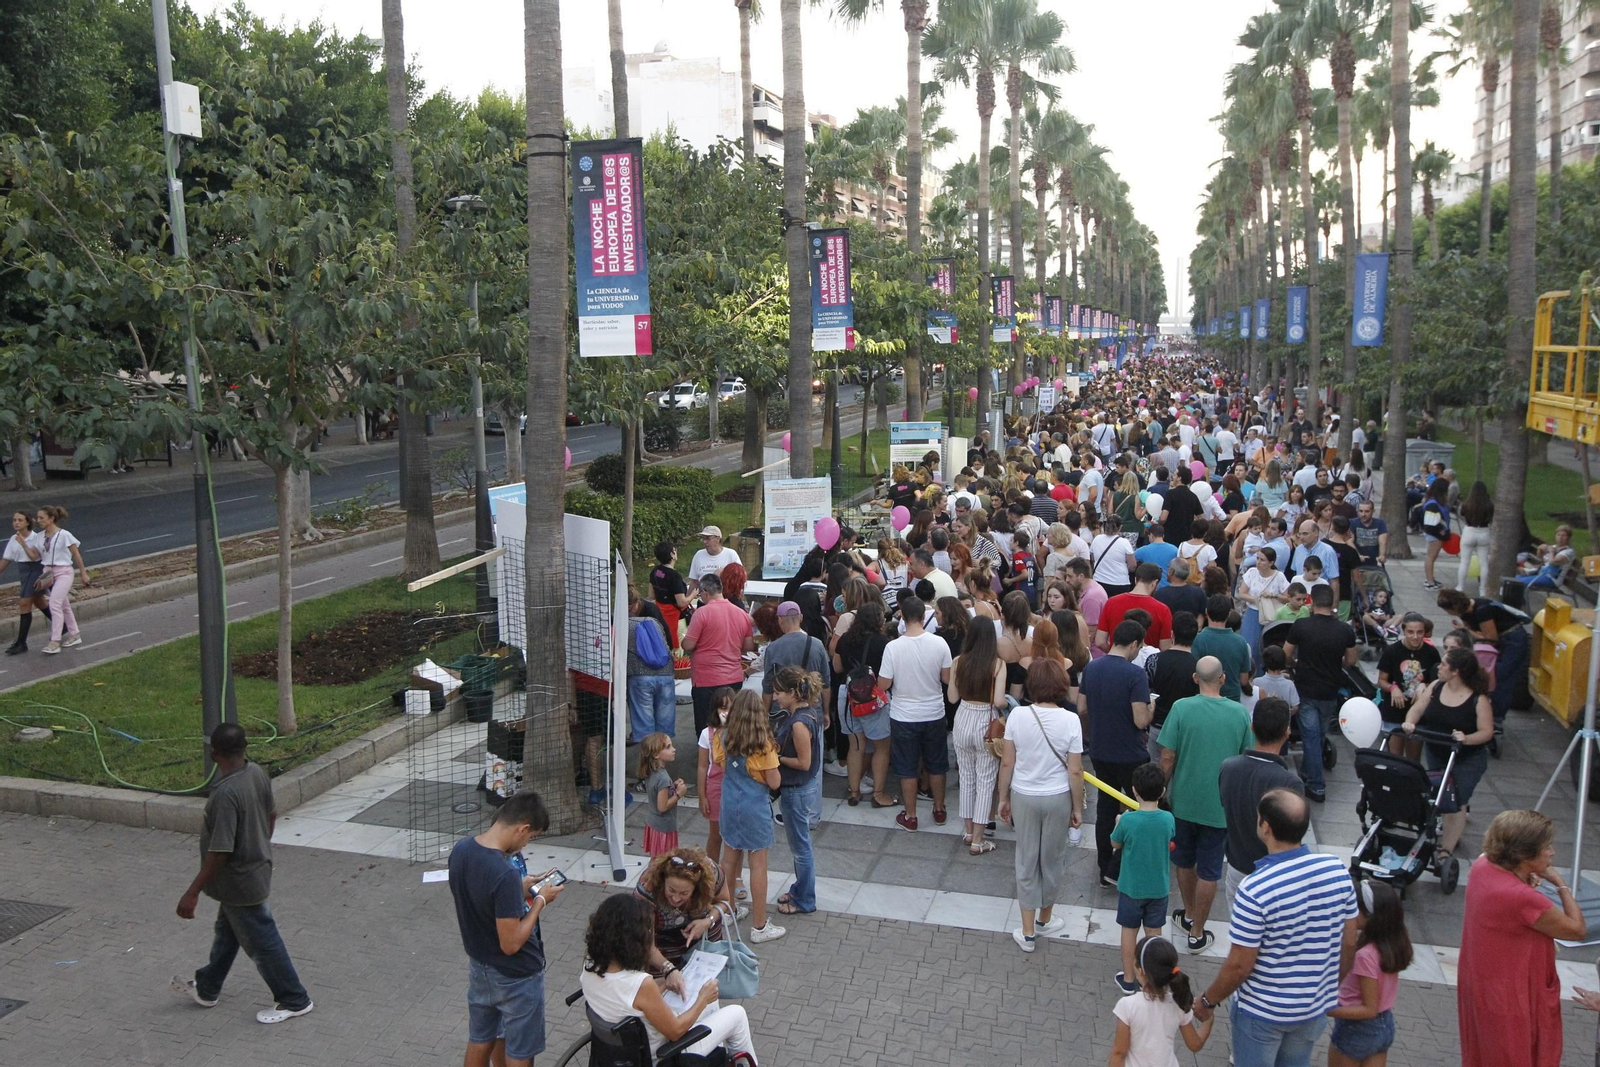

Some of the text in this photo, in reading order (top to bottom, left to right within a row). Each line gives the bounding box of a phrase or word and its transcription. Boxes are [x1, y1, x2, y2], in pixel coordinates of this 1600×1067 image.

[605, 158, 619, 272] EUROPEA DE L@S
[620, 157, 634, 271] INVESTIGADOR@S
[592, 203, 605, 272] LA NOCHE
[829, 256, 834, 266] DE
[823, 294, 828, 304] LA
[1363, 270, 1371, 313] UNIVERSIDAD
[1369, 303, 1375, 313] DE
[638, 322, 648, 330] 57
[1028, 567, 1034, 582] 10
